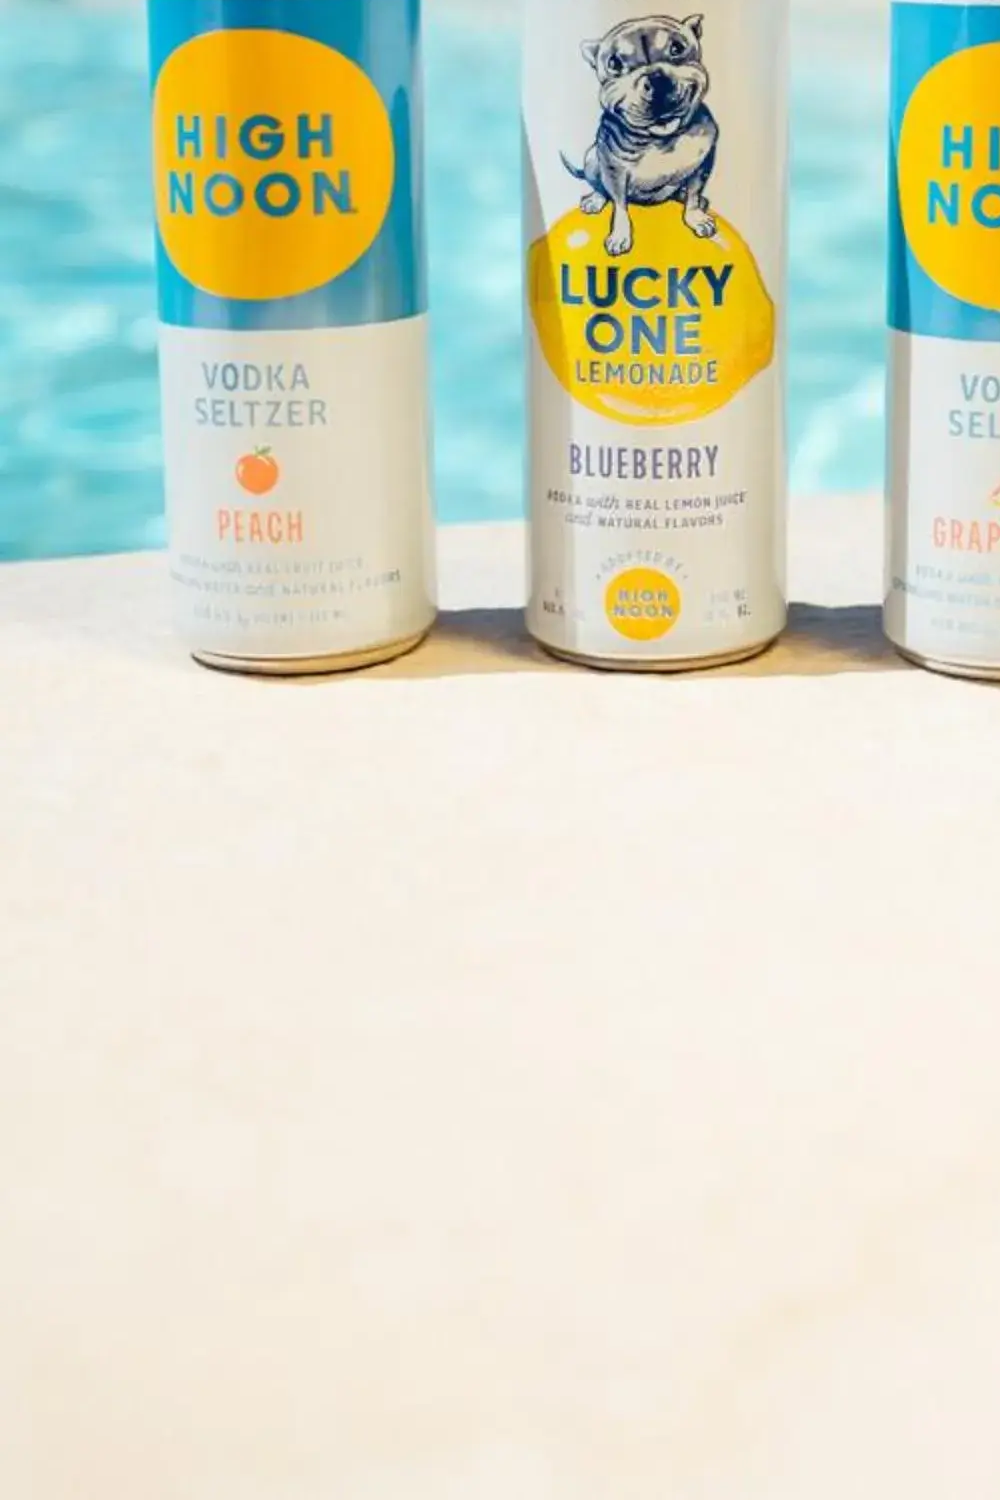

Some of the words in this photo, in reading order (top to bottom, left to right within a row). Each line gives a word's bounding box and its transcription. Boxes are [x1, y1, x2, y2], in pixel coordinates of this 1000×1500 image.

[177, 114, 333, 160] HIGH
[169, 170, 351, 218] NOON
[561, 264, 734, 309] LUCKY
[585, 313, 702, 354] ONE
[202, 363, 310, 392] VODKA
[576, 360, 719, 385] LEMONADE
[195, 398, 328, 428] SELTZER
[569, 444, 719, 480] BLUEBERRY
[665, 497, 711, 511] LEMON
[217, 509, 304, 544] PEACH
[598, 516, 659, 529] NATURAL
[664, 513, 724, 529] FLAVORS
[613, 604, 673, 617] NOON
